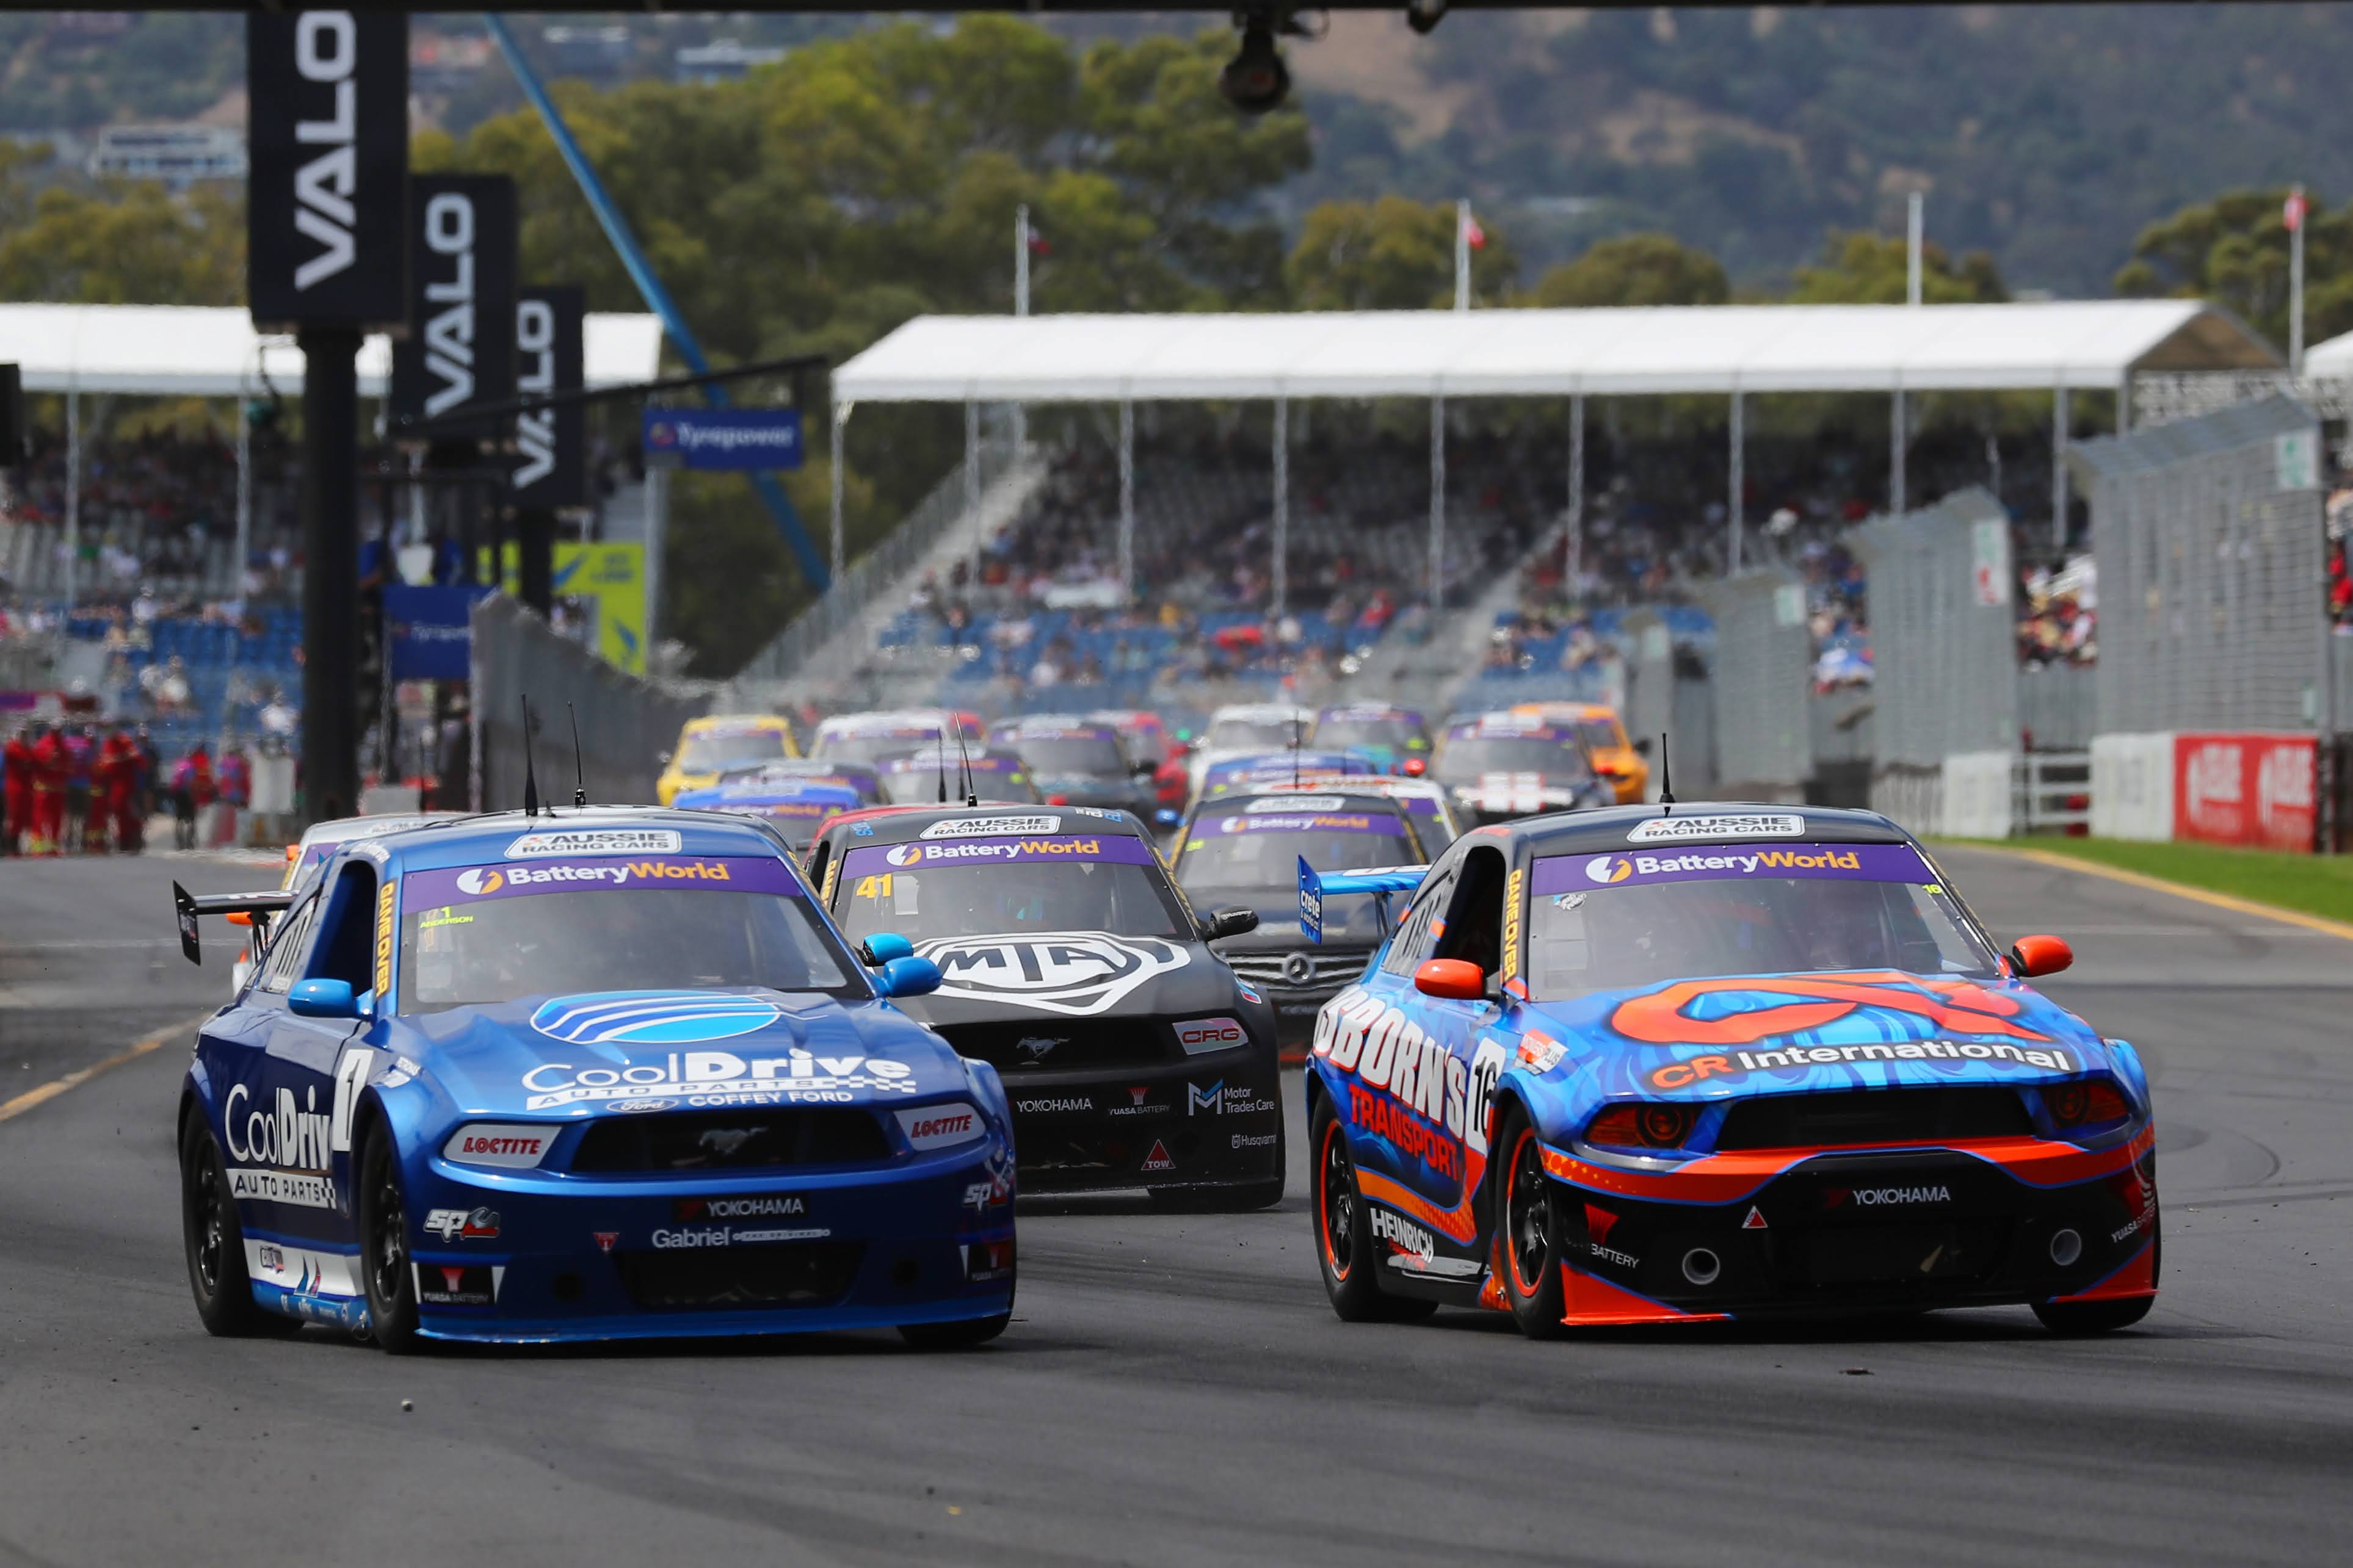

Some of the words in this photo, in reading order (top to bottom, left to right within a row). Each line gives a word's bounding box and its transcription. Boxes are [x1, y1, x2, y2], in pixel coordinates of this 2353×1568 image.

[295, 9, 356, 291] VALO
[425, 192, 476, 417] VALO
[513, 300, 555, 490] VALO
[934, 826, 1004, 836] RACING
[1007, 825, 1050, 833] CARS
[959, 818, 1051, 828] AUSSIE
[1645, 827, 1731, 837] RACING
[1673, 817, 1791, 828] AUSSIE
[523, 843, 604, 853] RACING
[551, 833, 669, 844] AUSSIE
[856, 873, 893, 898] 41
[1922, 884, 1943, 894] 16
[441, 906, 451, 918] 1
[1182, 1027, 1241, 1044] CRG
[521, 1048, 913, 1092] CoolDrive
[1651, 1056, 1733, 1089] CR
[1738, 1040, 2072, 1072] International
[347, 1058, 361, 1141] 1
[538, 1088, 651, 1107] AUTO
[680, 1079, 816, 1093] PARTS
[687, 1092, 787, 1107] COFFEY
[791, 1091, 854, 1104] FORD
[1225, 1087, 1252, 1099] Motor
[1474, 1057, 1496, 1138] 16
[620, 1100, 666, 1112] Ford
[1017, 1098, 1093, 1113] YOKOHAMA
[1109, 1107, 1137, 1116] YUASA
[1137, 1105, 1170, 1114] BATTERY
[1225, 1101, 1255, 1114] Trades
[1256, 1099, 1275, 1111] Care
[225, 1083, 333, 1171] CoolDriv
[912, 1114, 972, 1138] LOCTITE
[1348, 1083, 1463, 1182] TRANSPORT
[463, 1136, 542, 1156] LOCTITE
[1147, 1160, 1170, 1169] TOW
[234, 1174, 278, 1196] AUTO
[283, 1179, 320, 1204] PARTS
[1853, 1185, 1951, 1205] YOKOHAMA
[707, 1198, 805, 1216] YOKOHAMA
[652, 1227, 731, 1248] Gabriel
[1370, 1207, 1434, 1263] HEINRICH
[1591, 1243, 1640, 1269] BATTERY
